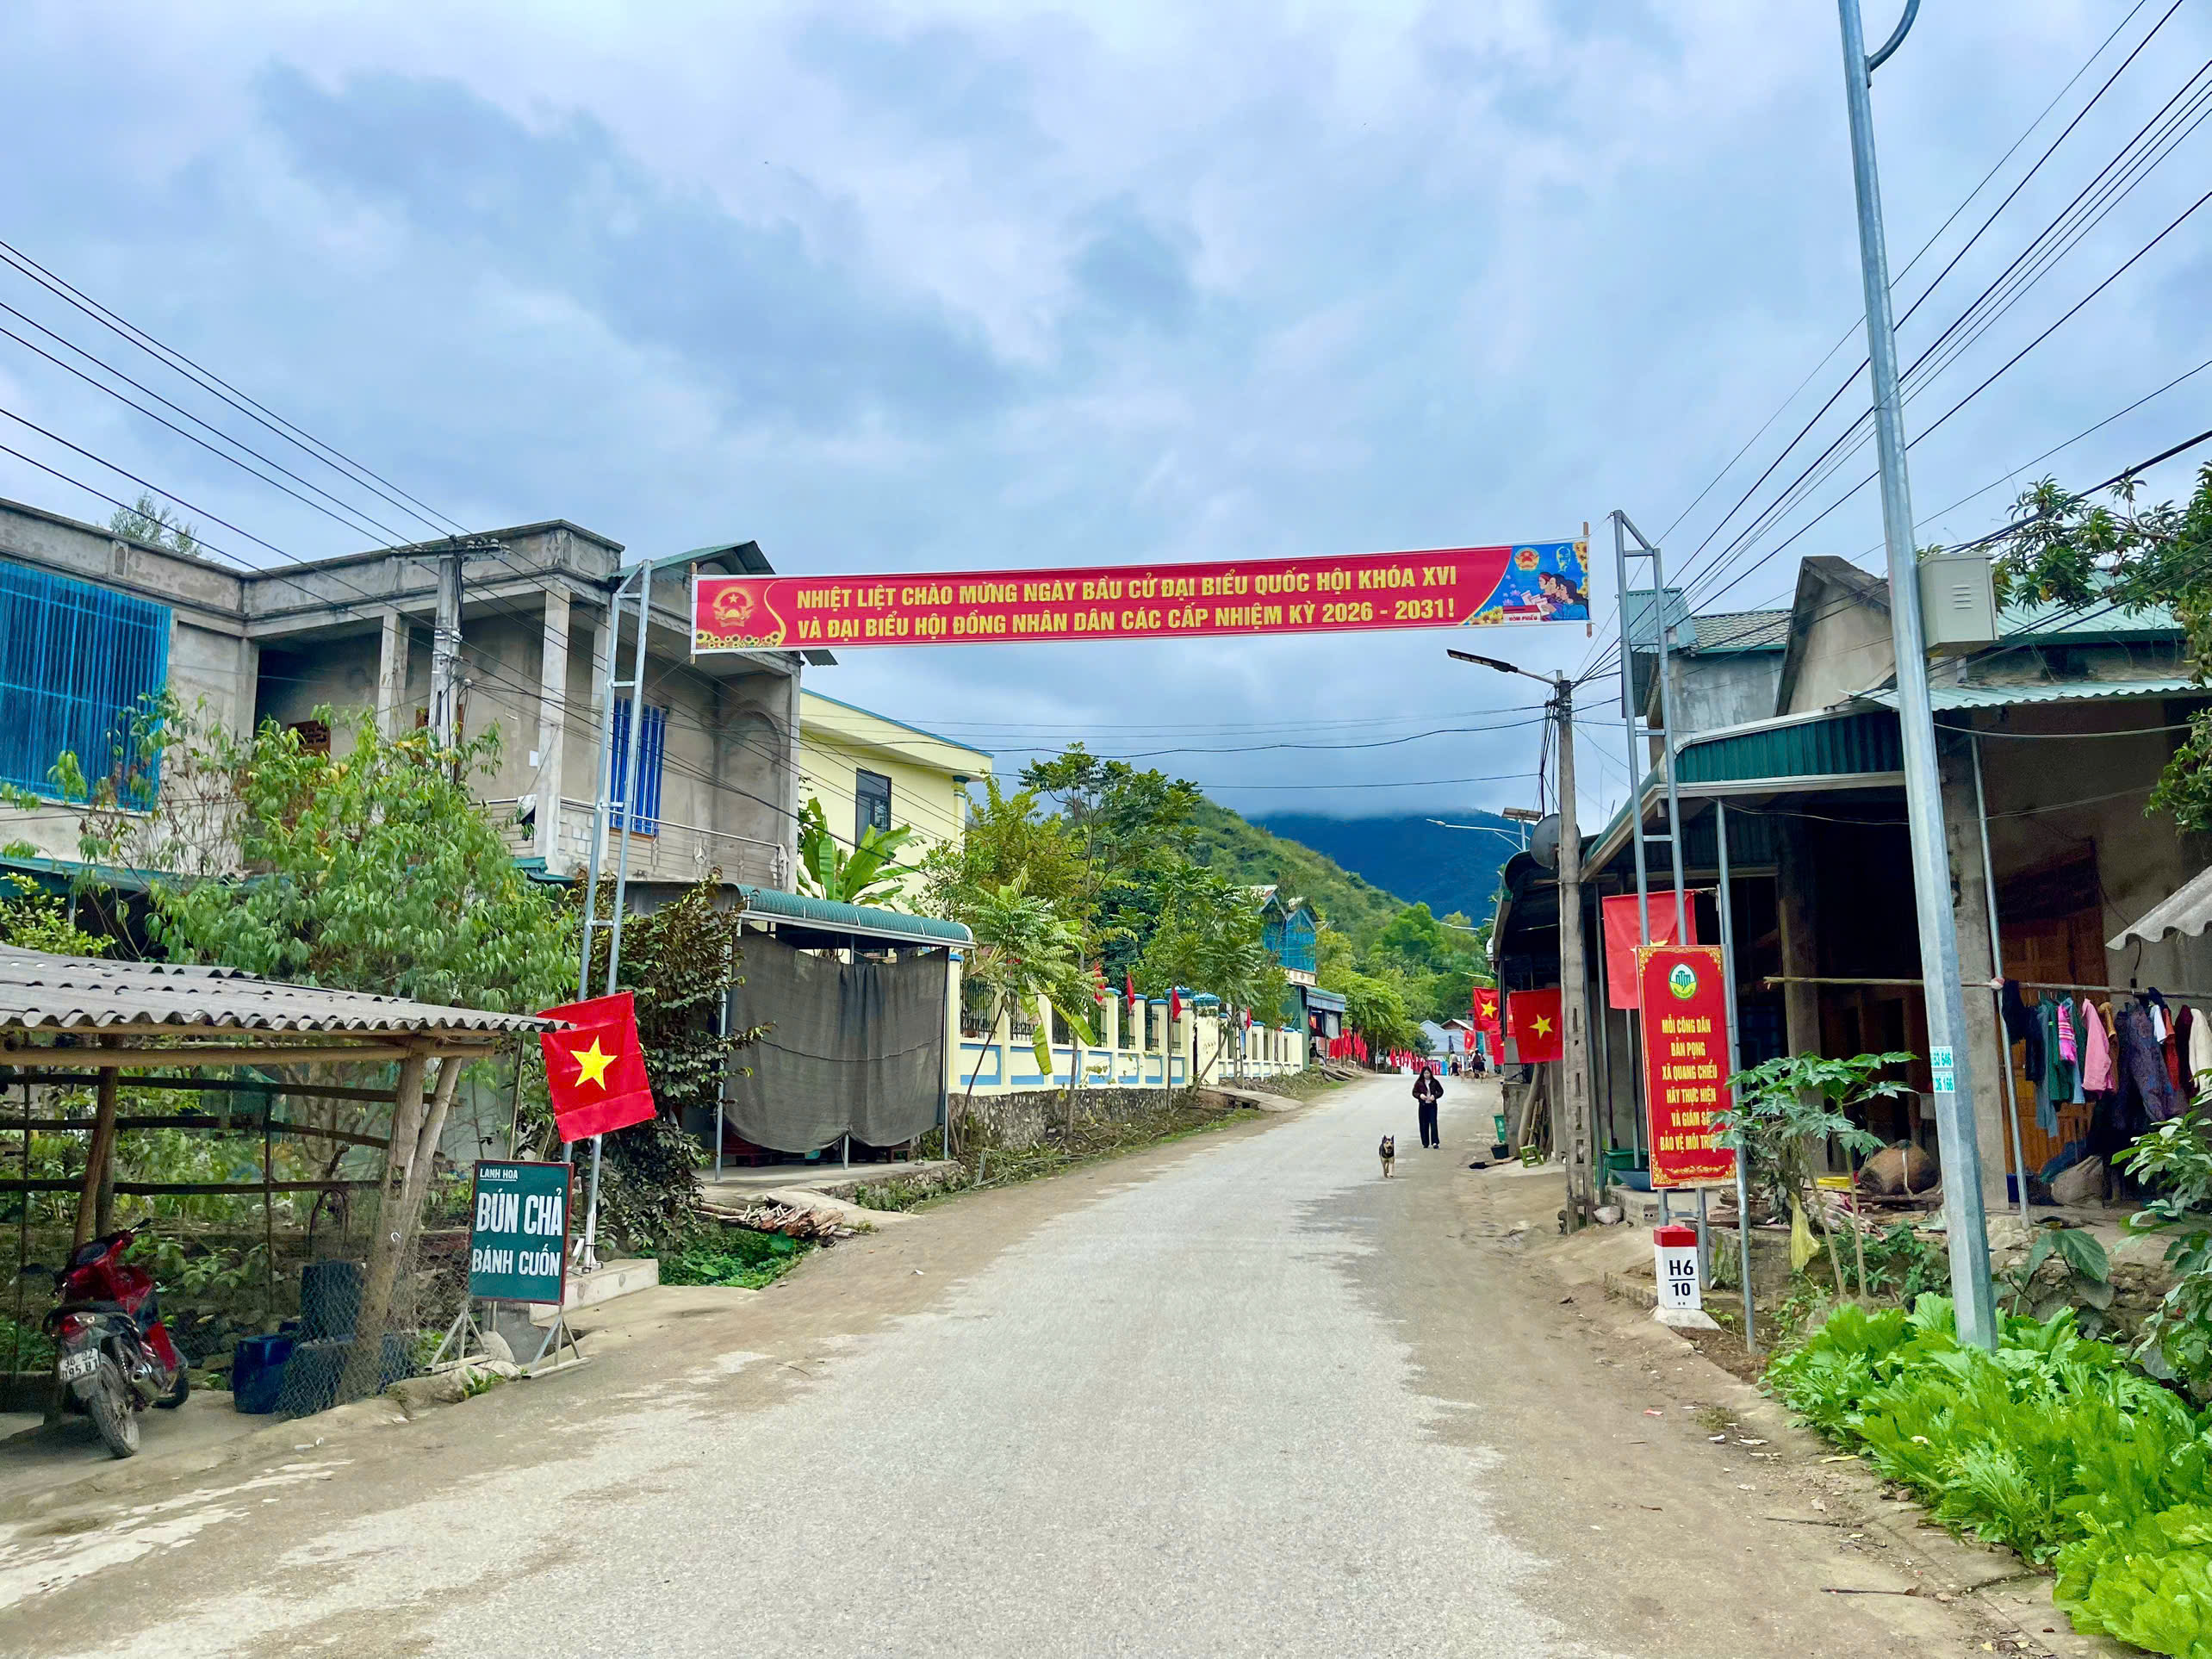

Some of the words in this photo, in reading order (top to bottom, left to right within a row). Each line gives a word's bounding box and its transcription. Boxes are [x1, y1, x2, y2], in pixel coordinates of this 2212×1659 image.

[797, 586, 852, 612] NHIỆT
[857, 585, 896, 611] LIỆT
[902, 583, 953, 606] CHÀO
[959, 581, 1017, 604] MỪNG
[1023, 580, 1076, 602] NGÀY
[1082, 575, 1122, 600] BẦU
[1128, 572, 1158, 599] CỬ
[1161, 578, 1196, 601] ĐẠI
[1202, 569, 1248, 596] BIỂU
[1254, 567, 1310, 596] QUỐC
[1316, 568, 1351, 594] HỘI
[1358, 564, 1415, 589] KHÓA
[1422, 566, 1457, 586] XVI
[798, 616, 822, 638] VÀ
[827, 618, 859, 642] ĐẠI
[865, 611, 909, 637] BIỂU
[915, 613, 947, 639] HỘI
[953, 610, 1006, 635] ĐỒNG
[1012, 610, 1067, 633] NHÂN
[1073, 608, 1115, 631] DÂN
[1122, 606, 1161, 630] CÁC
[1168, 602, 1209, 629] CẤP
[1215, 602, 1283, 630] NHIỆM
[1289, 600, 1315, 624] KỲ
[1322, 602, 1373, 623] 2026
[1395, 598, 1455, 620] 2031!
[1676, 1016, 1696, 1034] CÔNG
[1696, 1016, 1711, 1033] DÂN
[1670, 1036, 1686, 1057] BẢN
[1687, 1041, 1706, 1059] PỌNG
[1662, 1063, 1672, 1080] XÃ
[1673, 1065, 1696, 1081] QUANG
[1681, 1087, 1699, 1106] THỰC
[1699, 1085, 1717, 1106] HIỆN
[1671, 1109, 1681, 1127] VÀ
[1682, 1109, 1700, 1127] GIÁM
[1660, 1130, 1675, 1151] BẢO
[1675, 1133, 1684, 1153] VỆ
[1685, 1132, 1699, 1150] MÔI
[503, 1169, 518, 1179] HOA
[476, 1188, 519, 1233] BÚN
[524, 1187, 562, 1236] CHẢ
[472, 1245, 513, 1274] BÁNH
[519, 1243, 561, 1277] CUỐN
[1669, 1259, 1693, 1276] H6
[1672, 1283, 1691, 1296] 10
